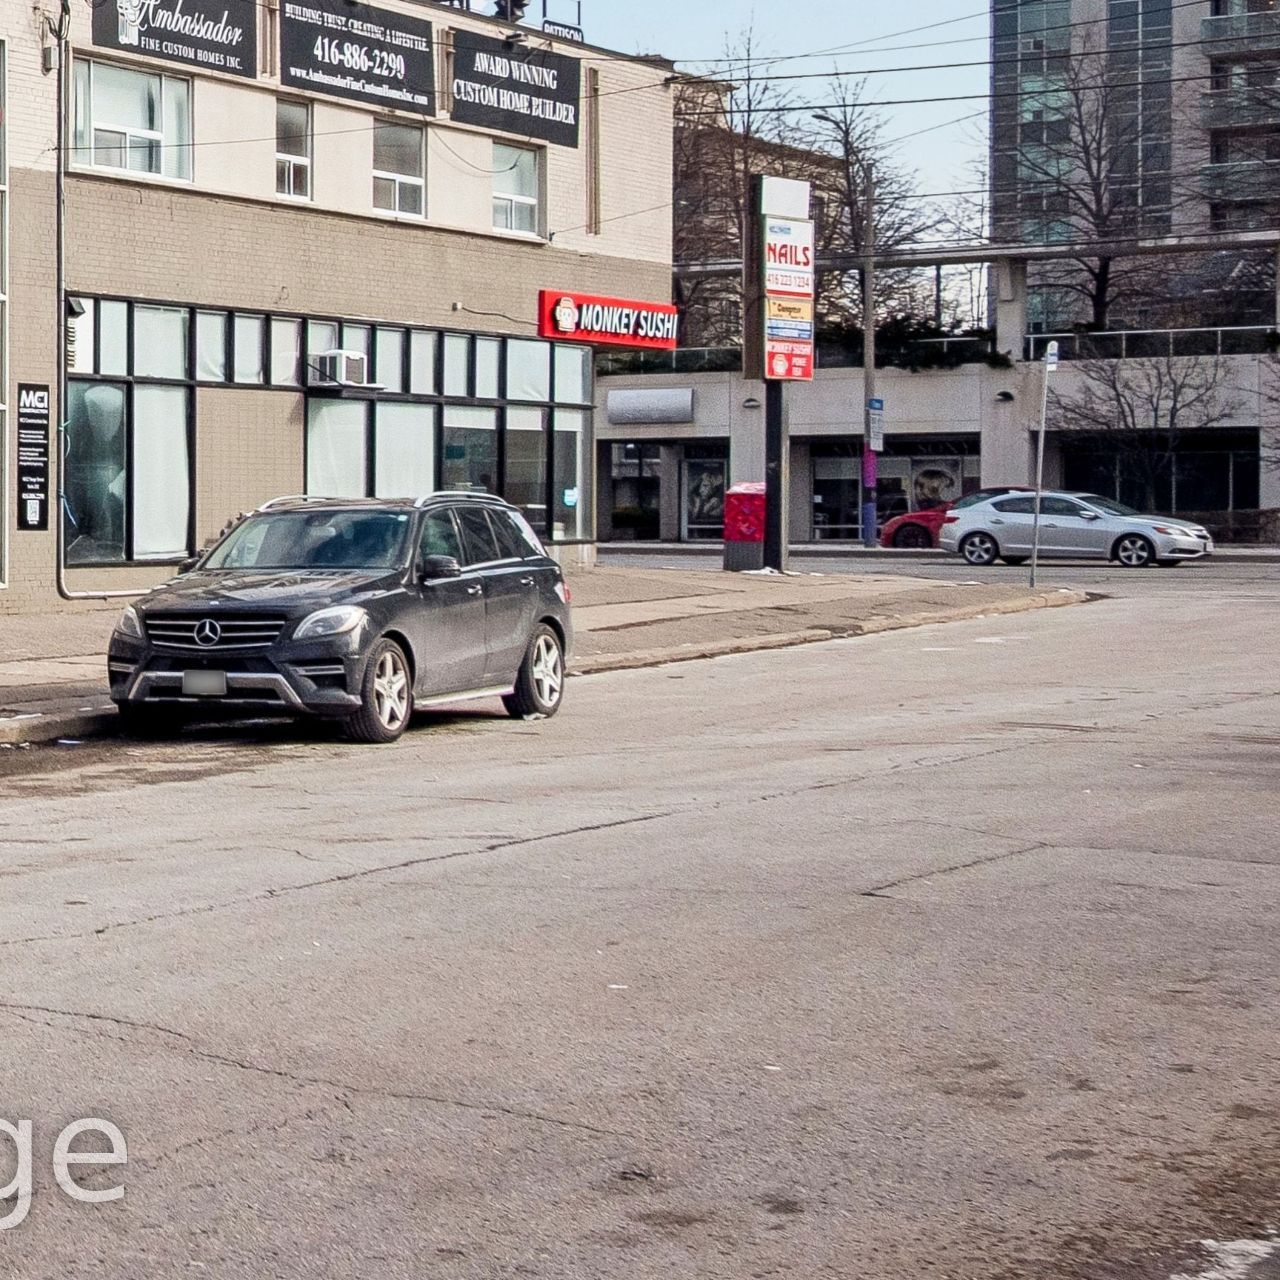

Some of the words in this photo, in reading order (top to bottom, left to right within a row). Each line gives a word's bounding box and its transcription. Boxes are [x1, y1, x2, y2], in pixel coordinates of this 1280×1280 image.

[140, 36, 161, 52] FINE
[162, 41, 195, 60] CUSTOM
[197, 49, 225, 65] HOMES
[226, 55, 243, 70] INC.
[473, 52, 510, 78] AWARD
[510, 60, 558, 89] WINNING
[453, 78, 499, 108] CUSTOM
[499, 88, 531, 115] HOME
[531, 96, 575, 125] BUILDER
[767, 242, 810, 267] NAILS
[581, 303, 638, 335] MONKEY
[638, 310, 679, 339] SUSHI
[20, 389, 49, 408] MCI
